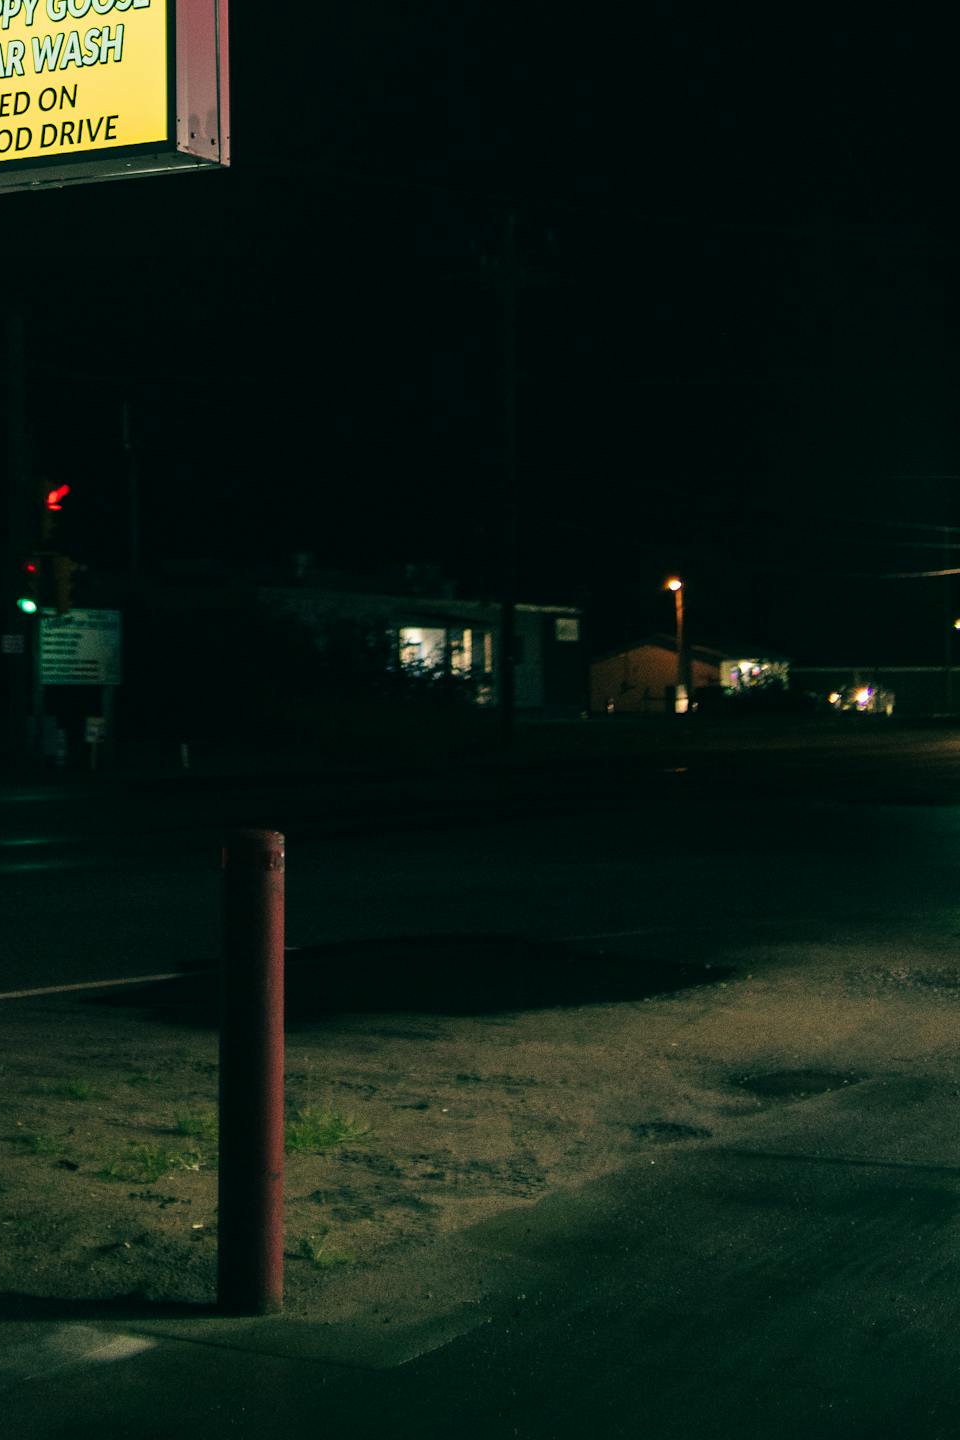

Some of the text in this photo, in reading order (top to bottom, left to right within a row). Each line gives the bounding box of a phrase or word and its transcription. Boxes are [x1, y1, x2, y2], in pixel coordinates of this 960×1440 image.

[31, 23, 125, 71] WASH
[39, 84, 78, 111] ON
[40, 115, 119, 148] DRIVE
